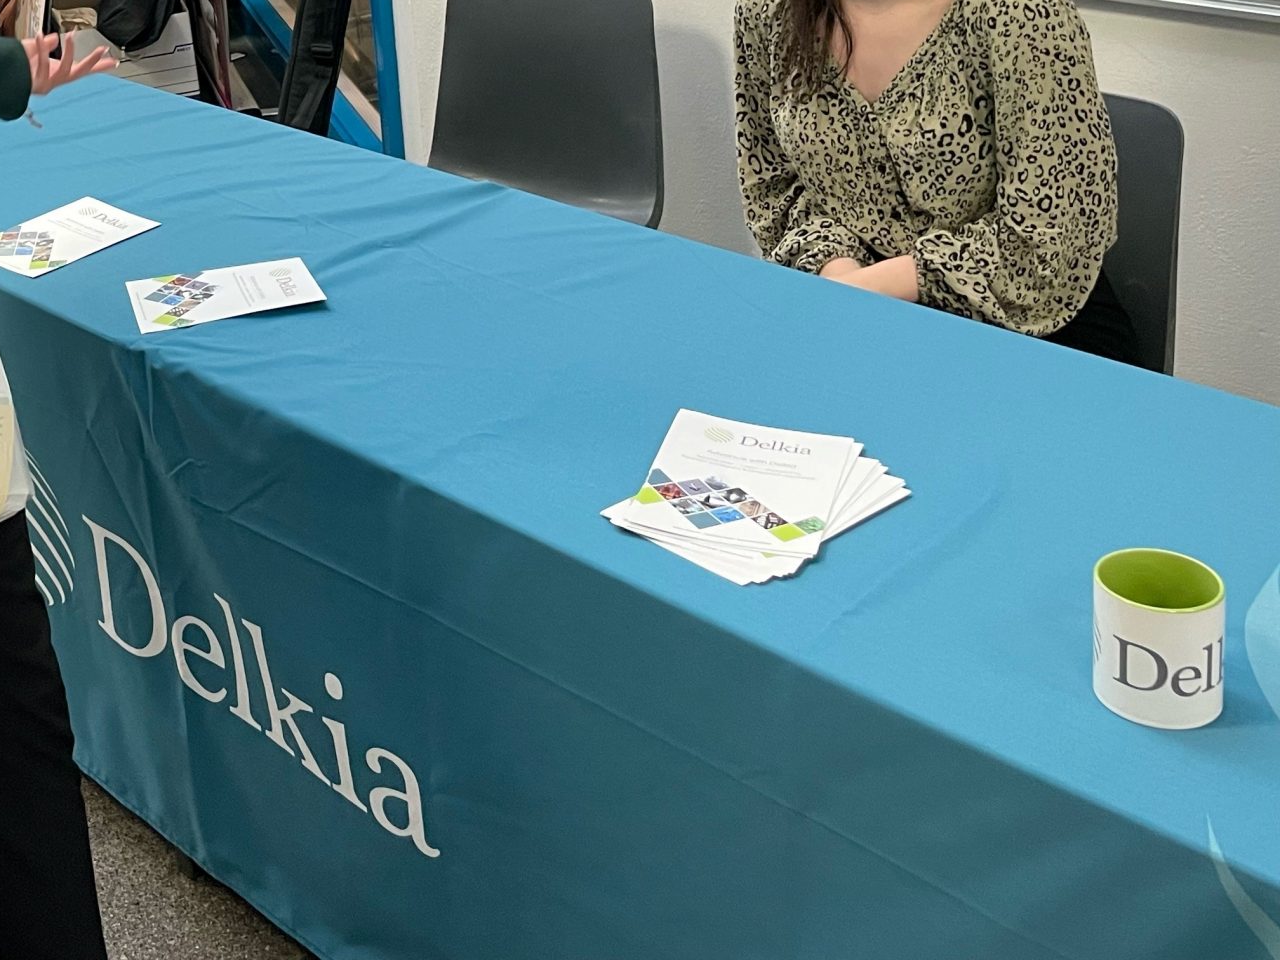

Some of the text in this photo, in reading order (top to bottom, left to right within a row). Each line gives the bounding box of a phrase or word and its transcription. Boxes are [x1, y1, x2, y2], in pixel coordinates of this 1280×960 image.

[93, 212, 128, 230] Delkia
[739, 435, 812, 456] Delkia
[81, 513, 441, 858] Delkia
